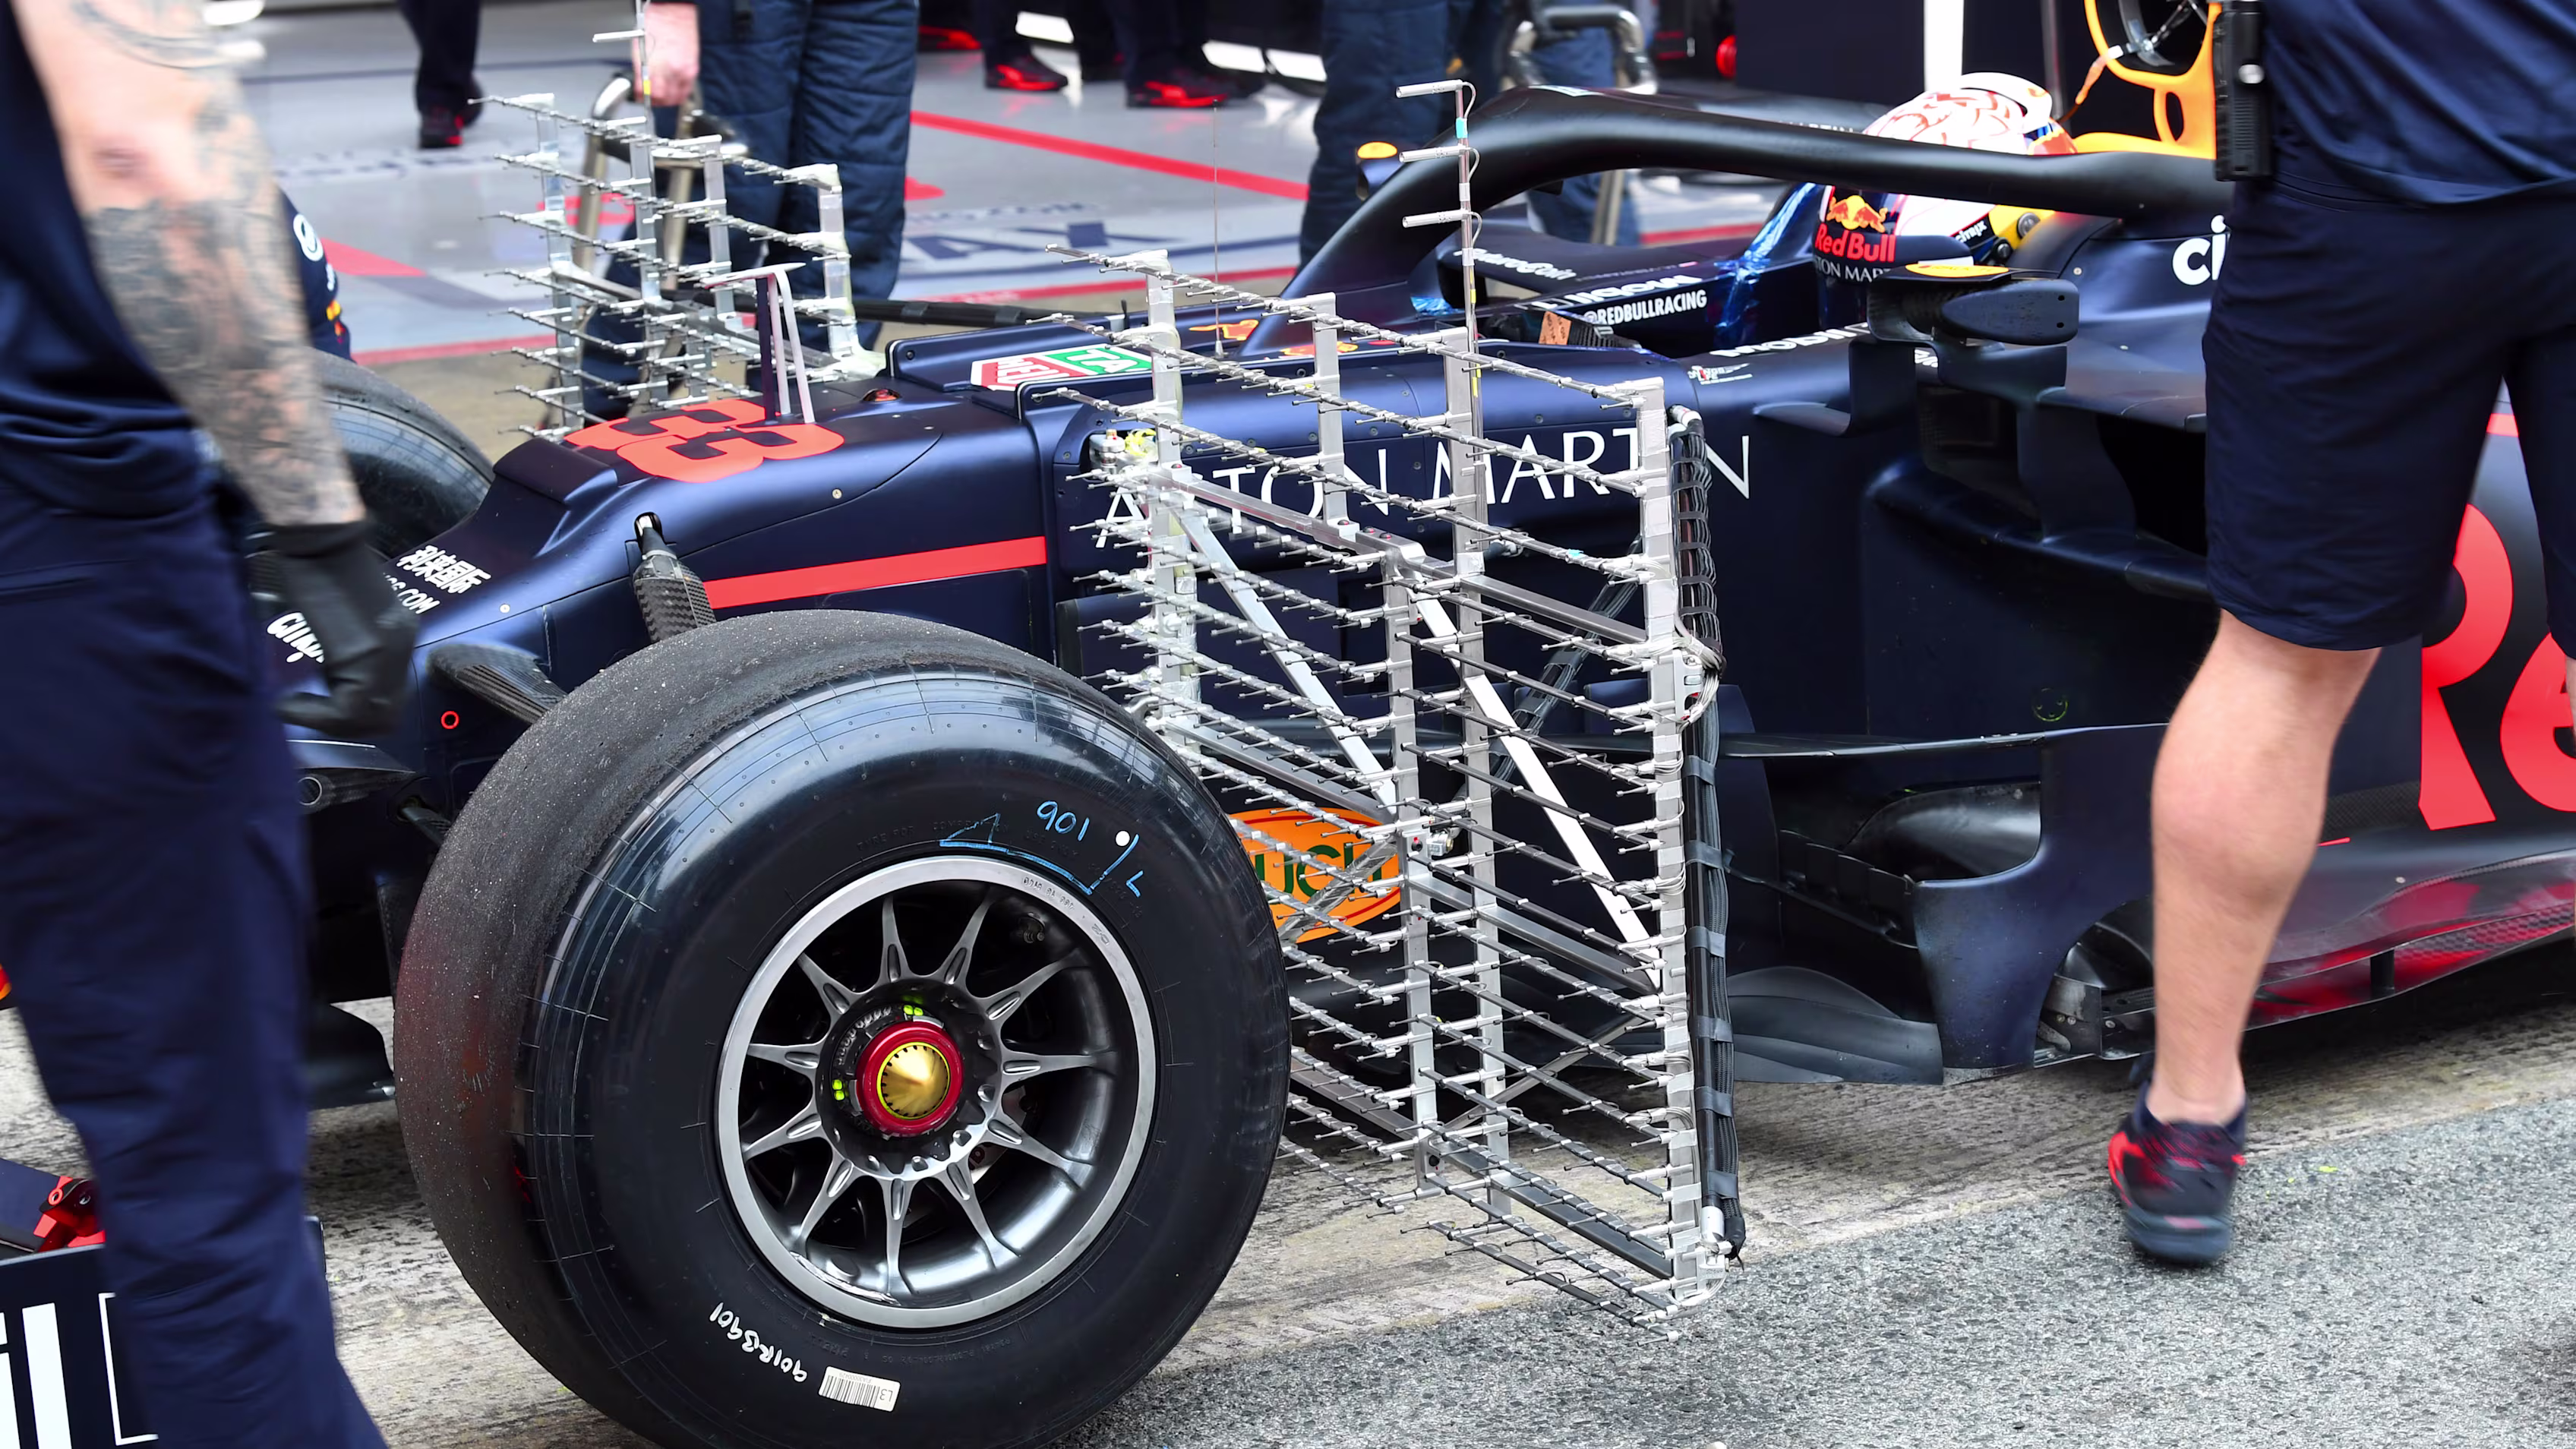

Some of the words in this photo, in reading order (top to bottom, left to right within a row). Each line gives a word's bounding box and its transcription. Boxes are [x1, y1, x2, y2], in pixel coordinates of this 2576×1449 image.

[1815, 223, 1848, 257] Red
[1847, 232, 1896, 263] Bull
[1814, 256, 1842, 278] TON
[1583, 289, 1708, 325] @REDBULLRACING
[1065, 349, 1152, 374] TA
[564, 399, 845, 484] 33
[1095, 449, 1389, 548] ATON
[1432, 428, 1750, 505] MARTN
[1036, 800, 1090, 841] 901
[879, 1388, 894, 1403] L3
